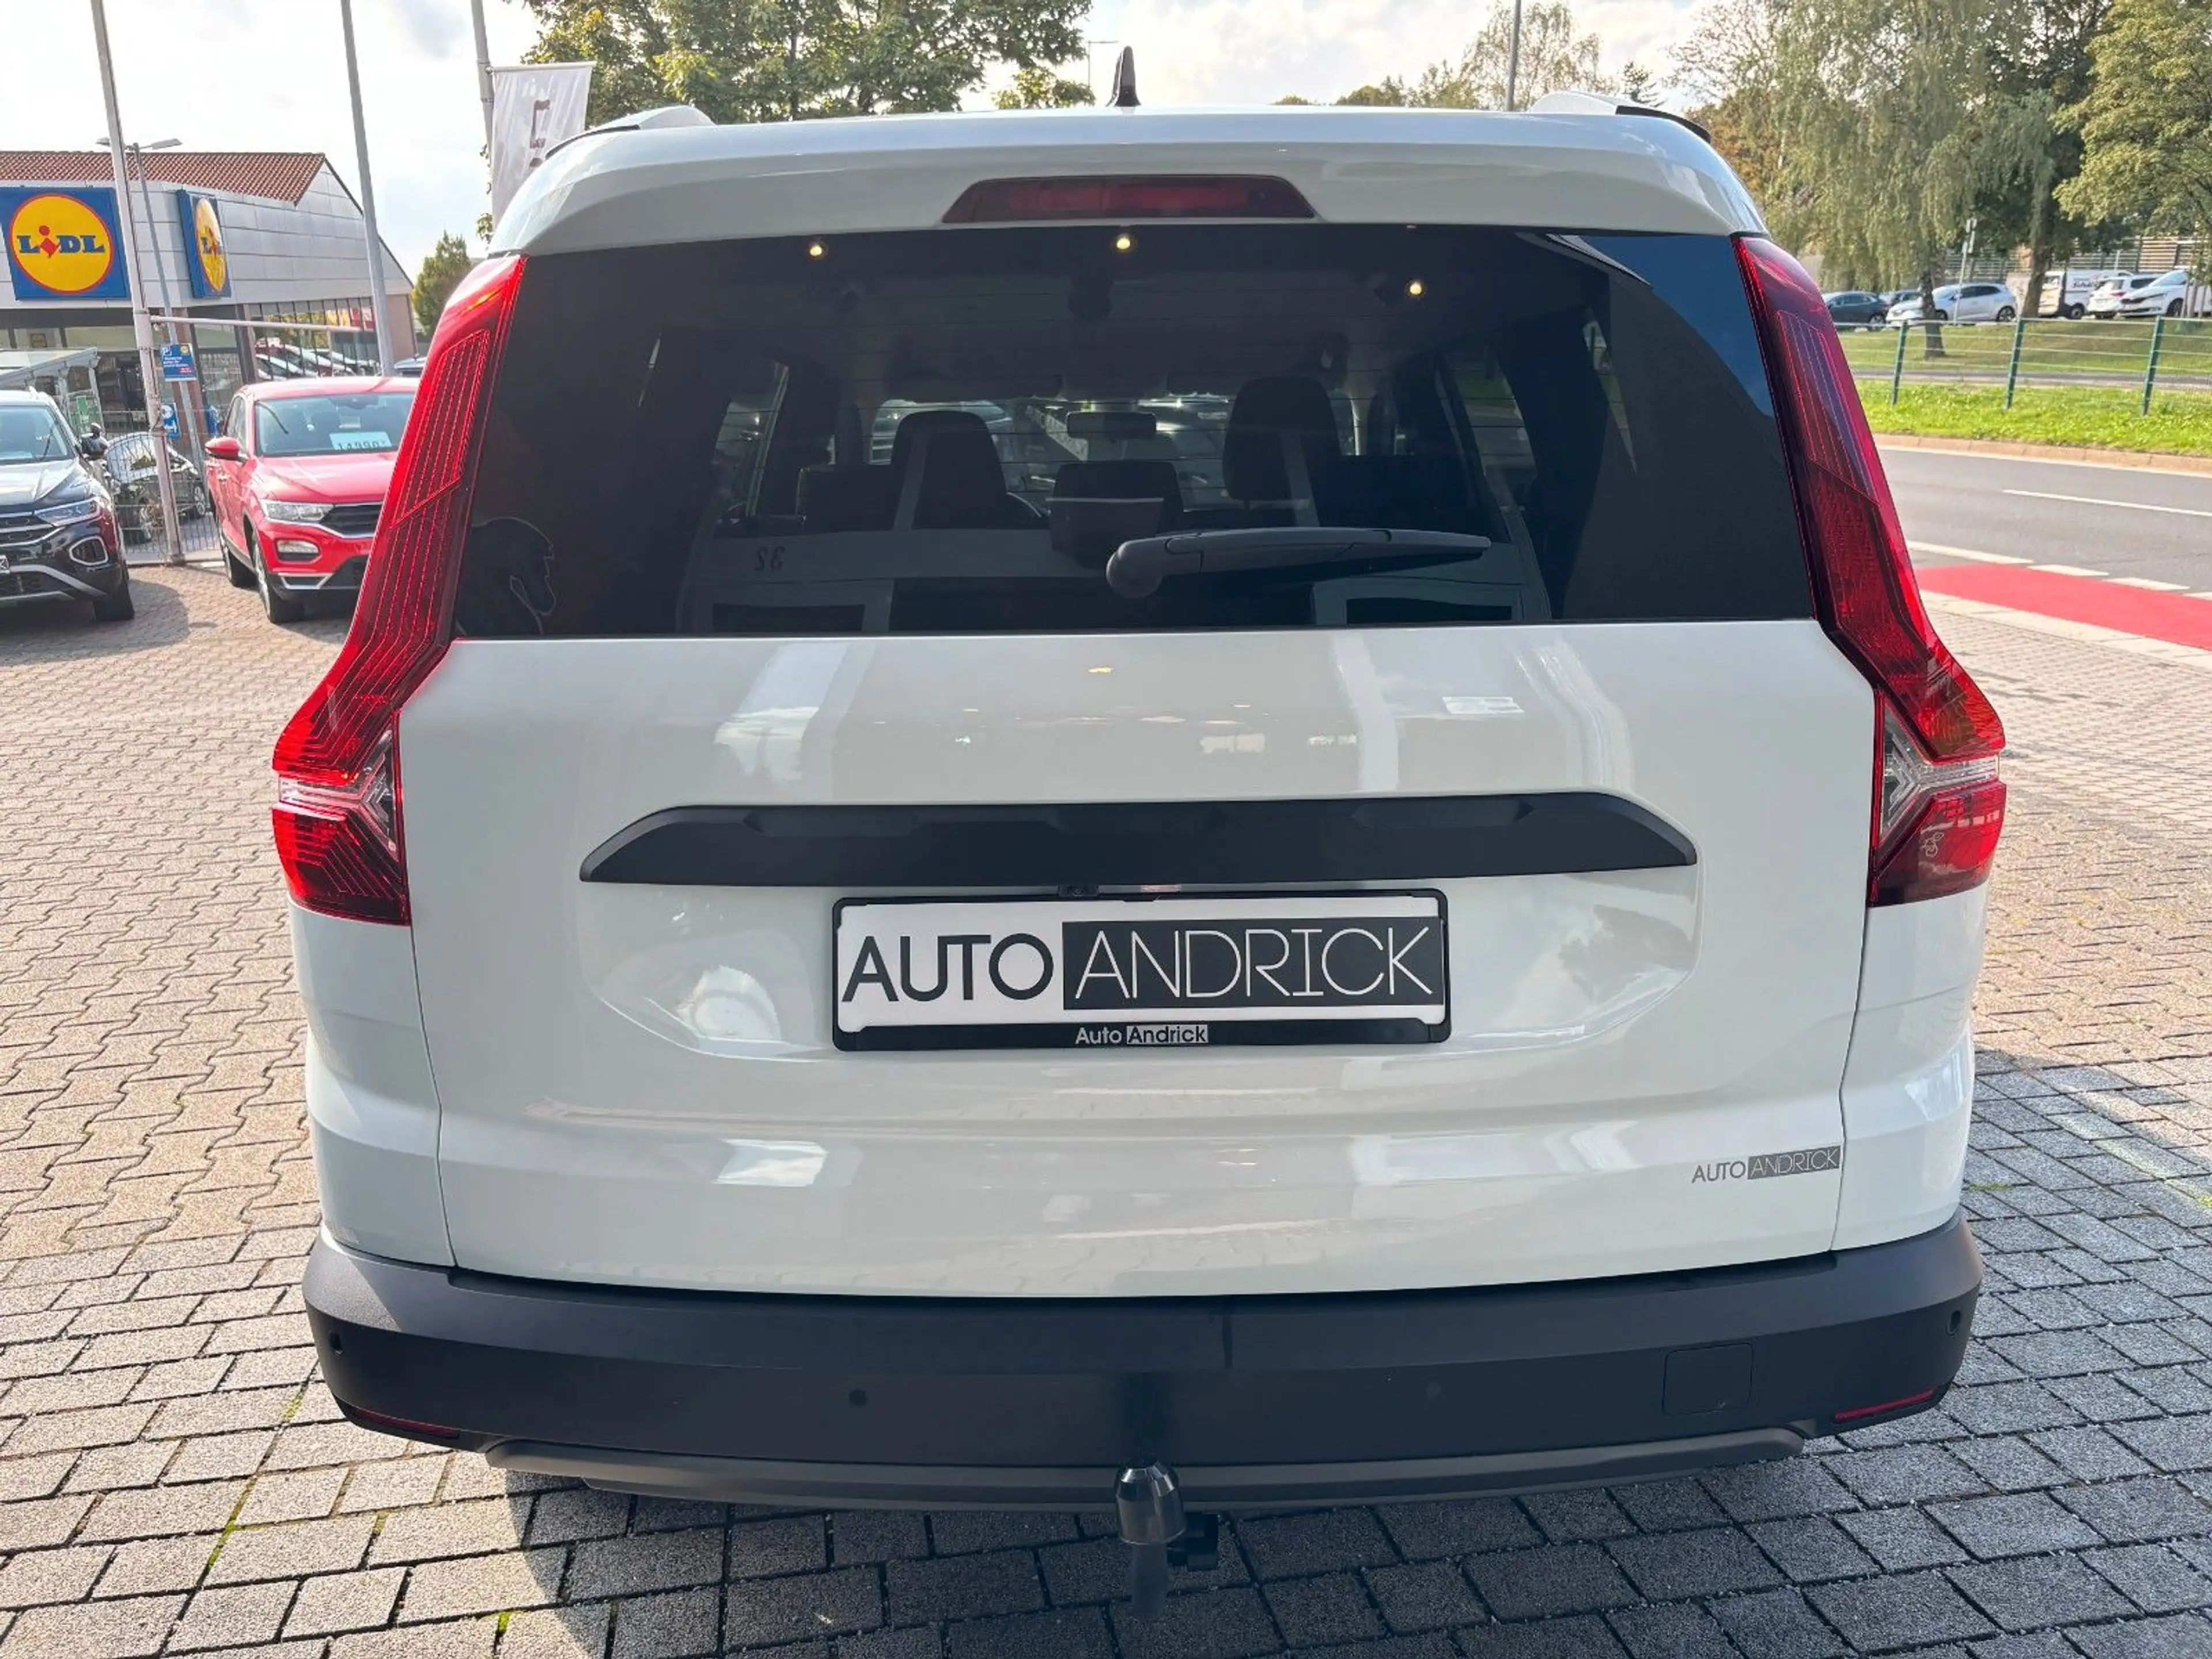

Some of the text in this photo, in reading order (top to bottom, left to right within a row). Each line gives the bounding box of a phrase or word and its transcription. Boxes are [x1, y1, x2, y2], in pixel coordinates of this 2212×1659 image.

[842, 927, 1433, 1003] AUTO ANDRICK
[1075, 1026, 1207, 1045] Auto Andrick
[1691, 1148, 1839, 1184] AUTO ANDRICK
